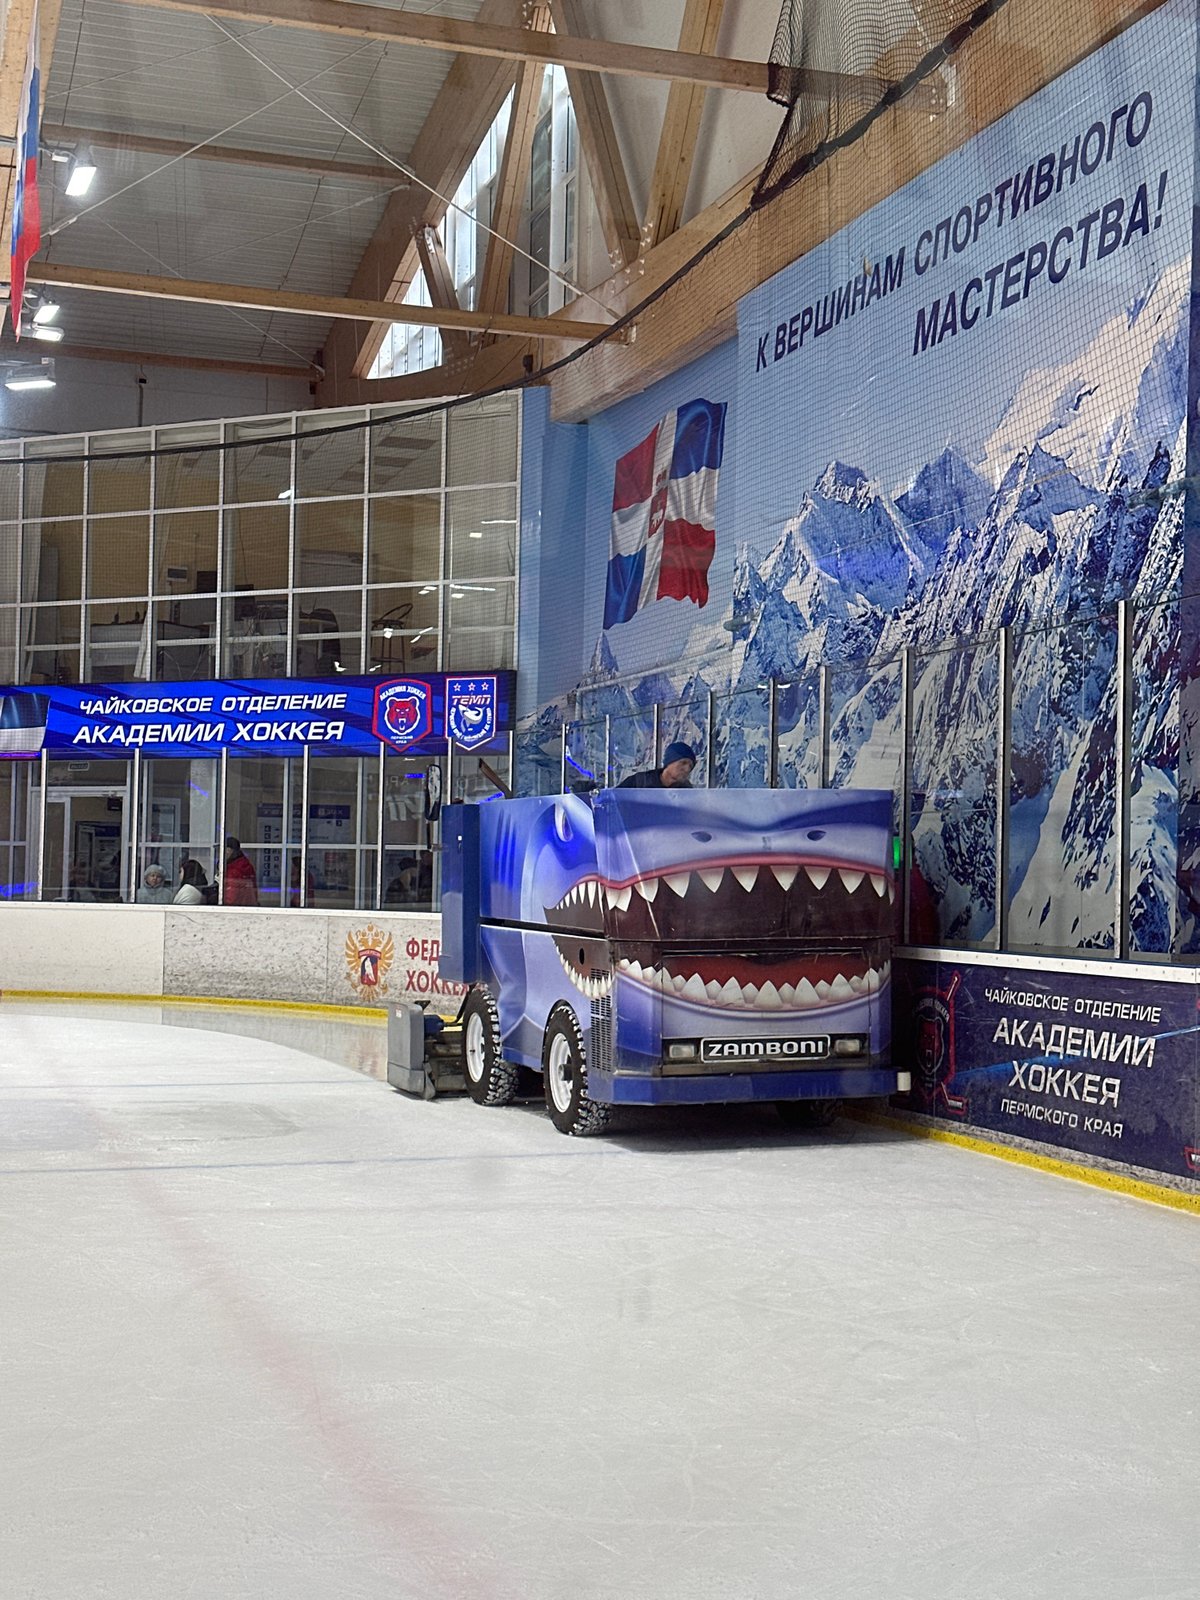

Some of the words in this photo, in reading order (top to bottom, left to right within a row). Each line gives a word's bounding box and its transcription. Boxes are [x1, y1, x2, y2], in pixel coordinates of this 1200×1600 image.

[756, 333, 770, 372] К
[774, 247, 906, 362] ВЕРШИНАМ
[914, 91, 1153, 276] СПОРТИВНОГО
[912, 170, 1168, 356] МАСТЕРСТВА!
[80, 696, 214, 715] ЧАЙКОВСКОЕ
[221, 693, 348, 714] ОТДЕЛЕНИЕ
[452, 694, 491, 706] ТЕМП
[72, 723, 225, 747] АКАДЕМИИ
[231, 721, 345, 742] ХОККЕЯ
[406, 937, 440, 966] ФЕД
[985, 987, 1069, 1012] ЧАЙКОВСКОЕ
[1075, 1000, 1162, 1023] ОТДЕЛЕНИЕ
[708, 1040, 823, 1057] ZAMBONI
[992, 1017, 1157, 1068] АКАДЕМИИ
[1008, 1060, 1121, 1108] ХОККЕЯ
[1001, 1099, 1079, 1129] ПЕРМСКОГО
[1084, 1117, 1123, 1139] КРАЯ
